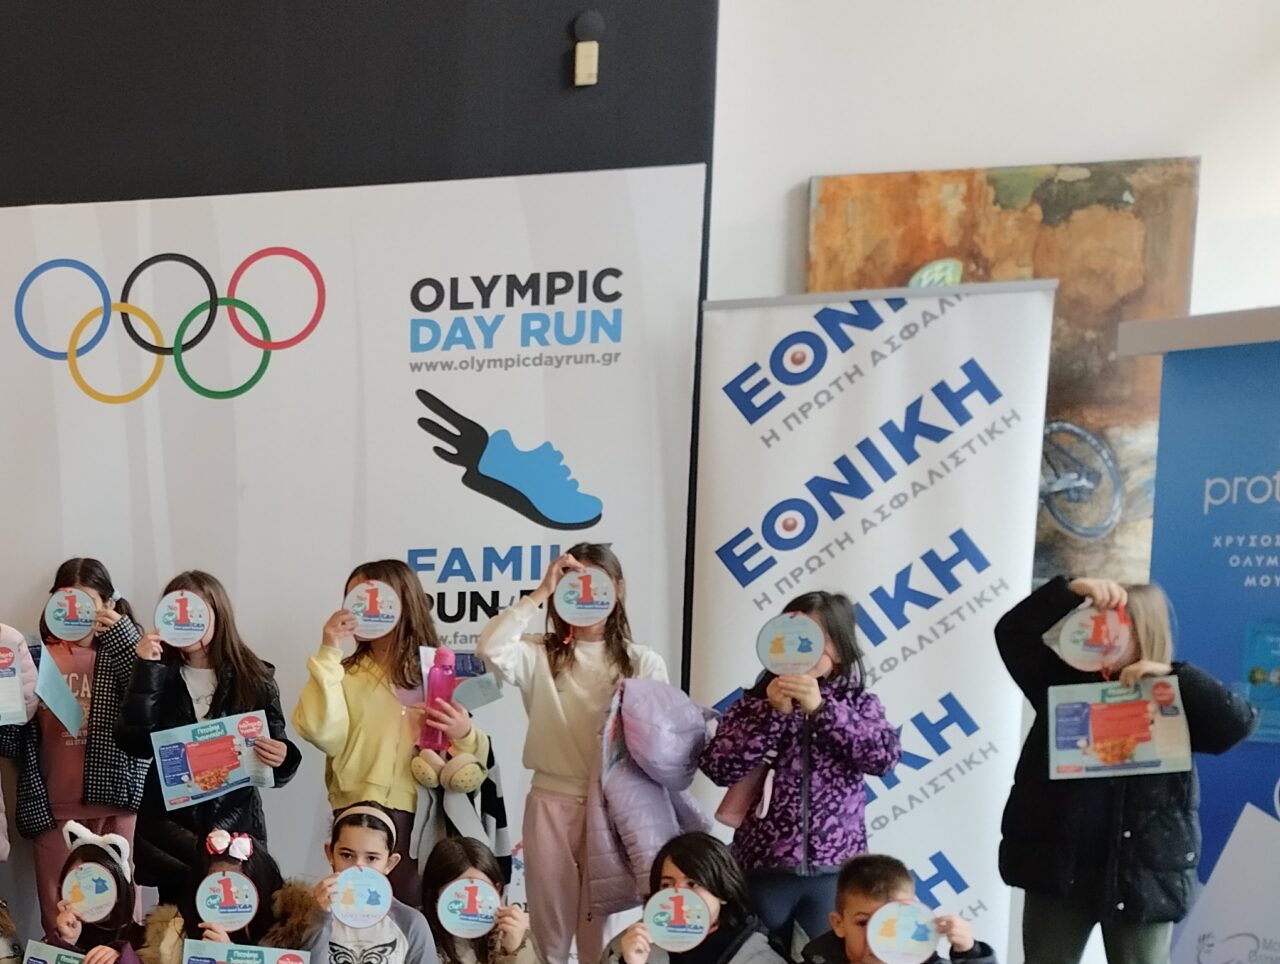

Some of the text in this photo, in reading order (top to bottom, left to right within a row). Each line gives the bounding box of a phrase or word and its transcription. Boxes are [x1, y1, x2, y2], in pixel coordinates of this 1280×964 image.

[410, 267, 624, 313] OLYMPIC
[409, 308, 623, 353] DAY RUN
[409, 350, 622, 373] www.olympicdayrun.gr
[782, 364, 866, 432] ΠΡΩΤΗ
[774, 531, 856, 596] ΠΡΩΤΗ
[859, 408, 1024, 536] ΑΣΦΑΛΙΣΤΙΚΗ
[865, 577, 1010, 688] ΣΦΑΛΙΣΤΙΚΗ
[868, 741, 999, 838] ΦΑΛΙΣΤΙΚΗ
[217, 877, 237, 907] 1
[464, 885, 480, 914] 1
[668, 895, 687, 926] 1
